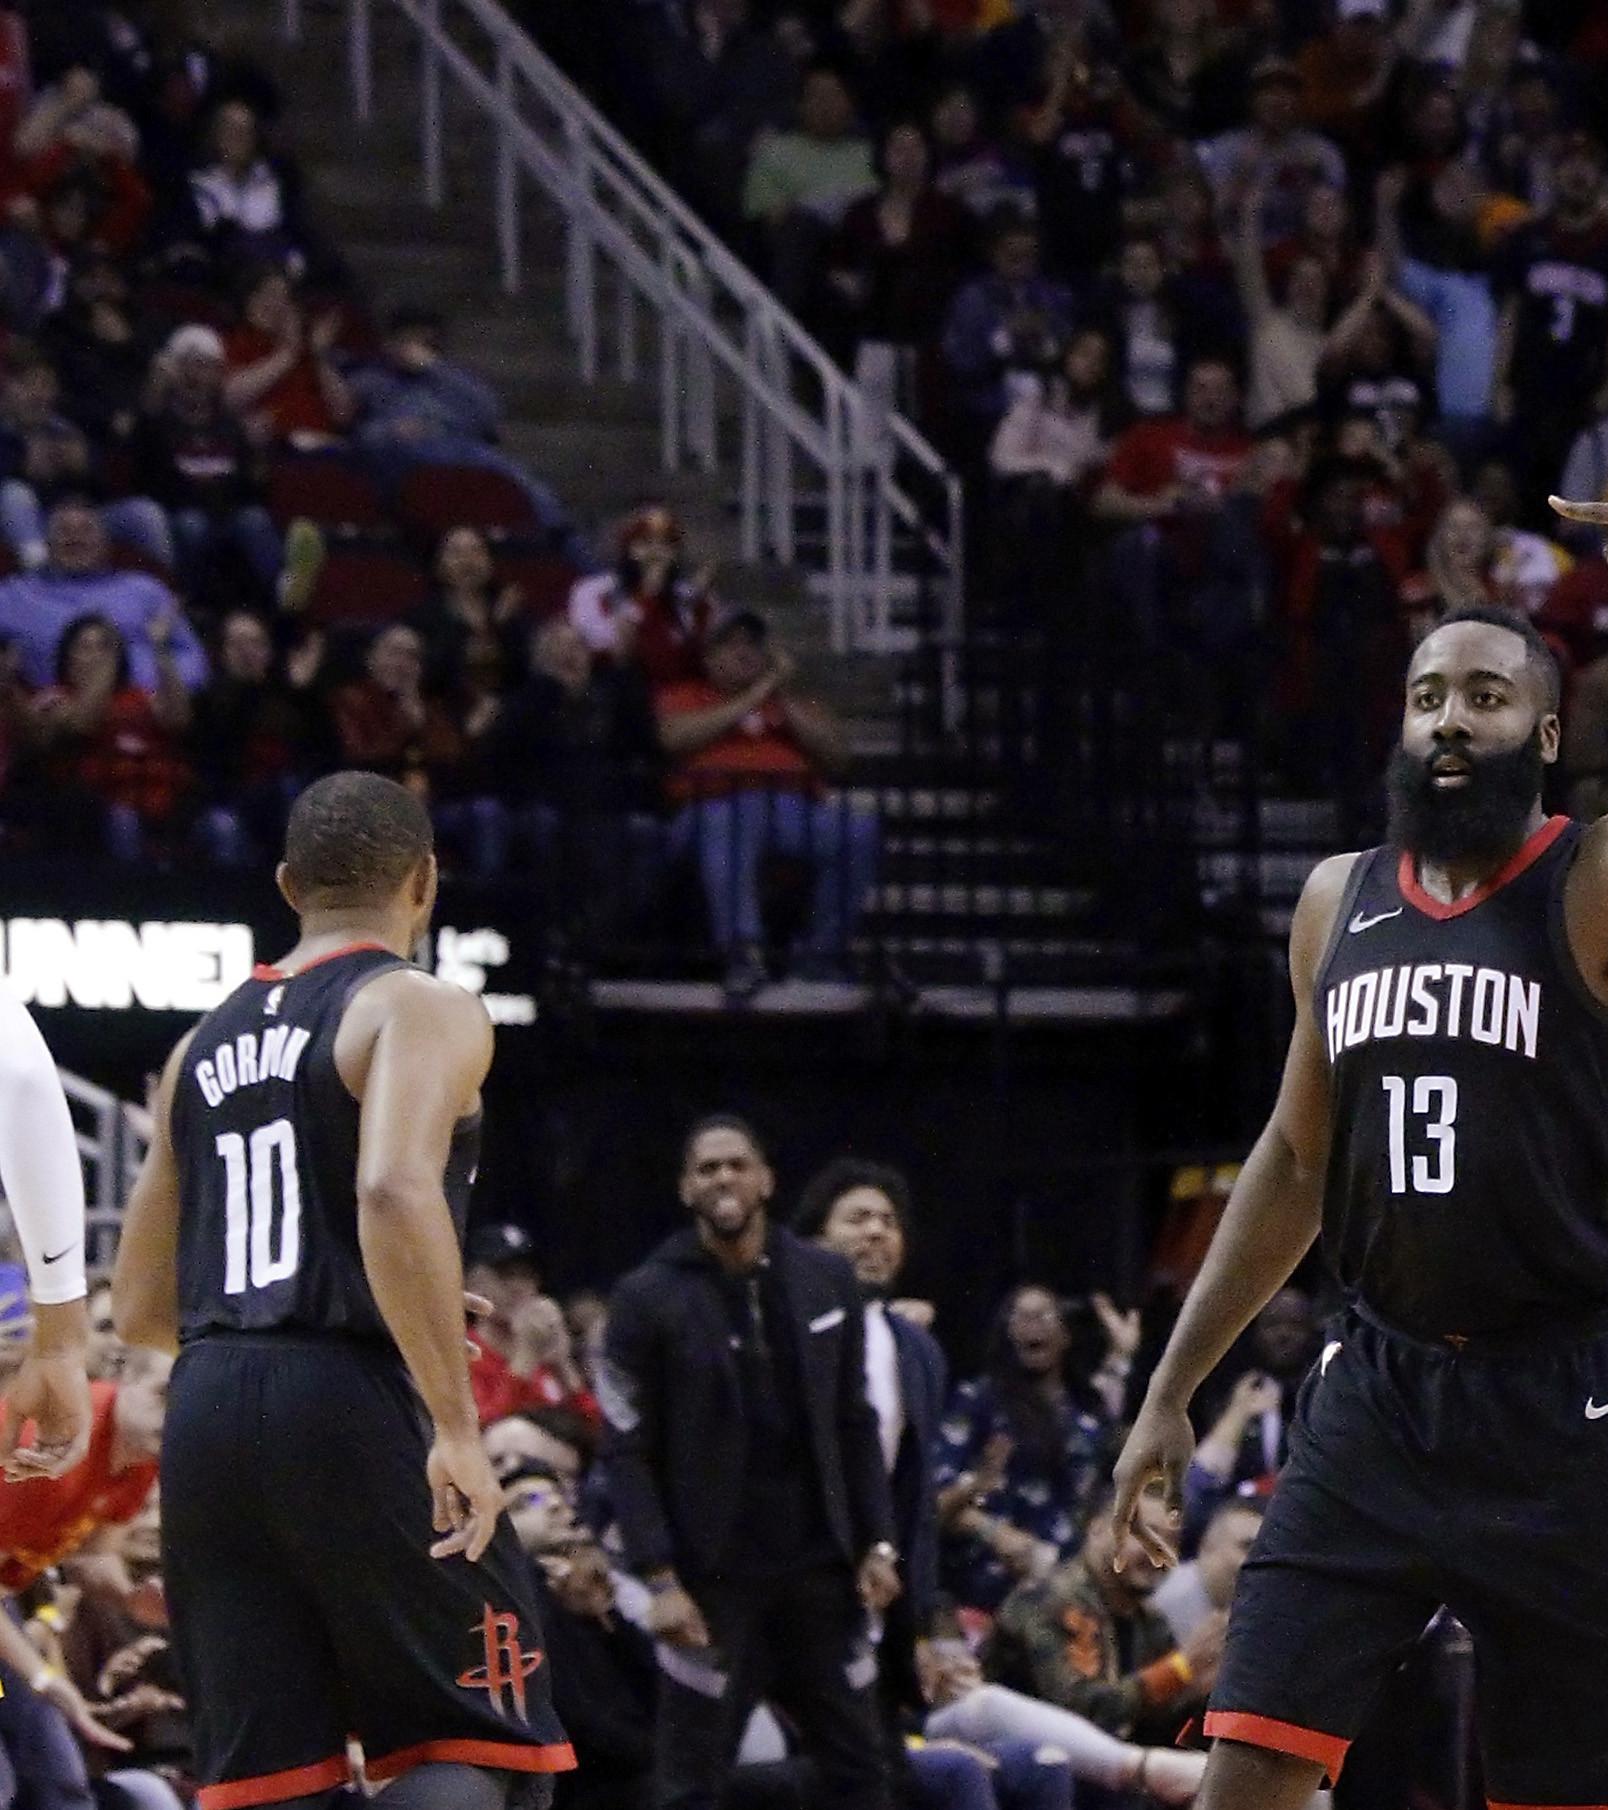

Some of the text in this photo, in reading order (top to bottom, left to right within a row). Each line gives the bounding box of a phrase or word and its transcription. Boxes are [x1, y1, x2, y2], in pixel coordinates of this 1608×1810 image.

[195, 1024, 311, 1107] GORN
[1327, 963, 1541, 1063] HOUSTON
[1382, 1075, 1458, 1194] 13
[215, 1118, 301, 1294] 10
